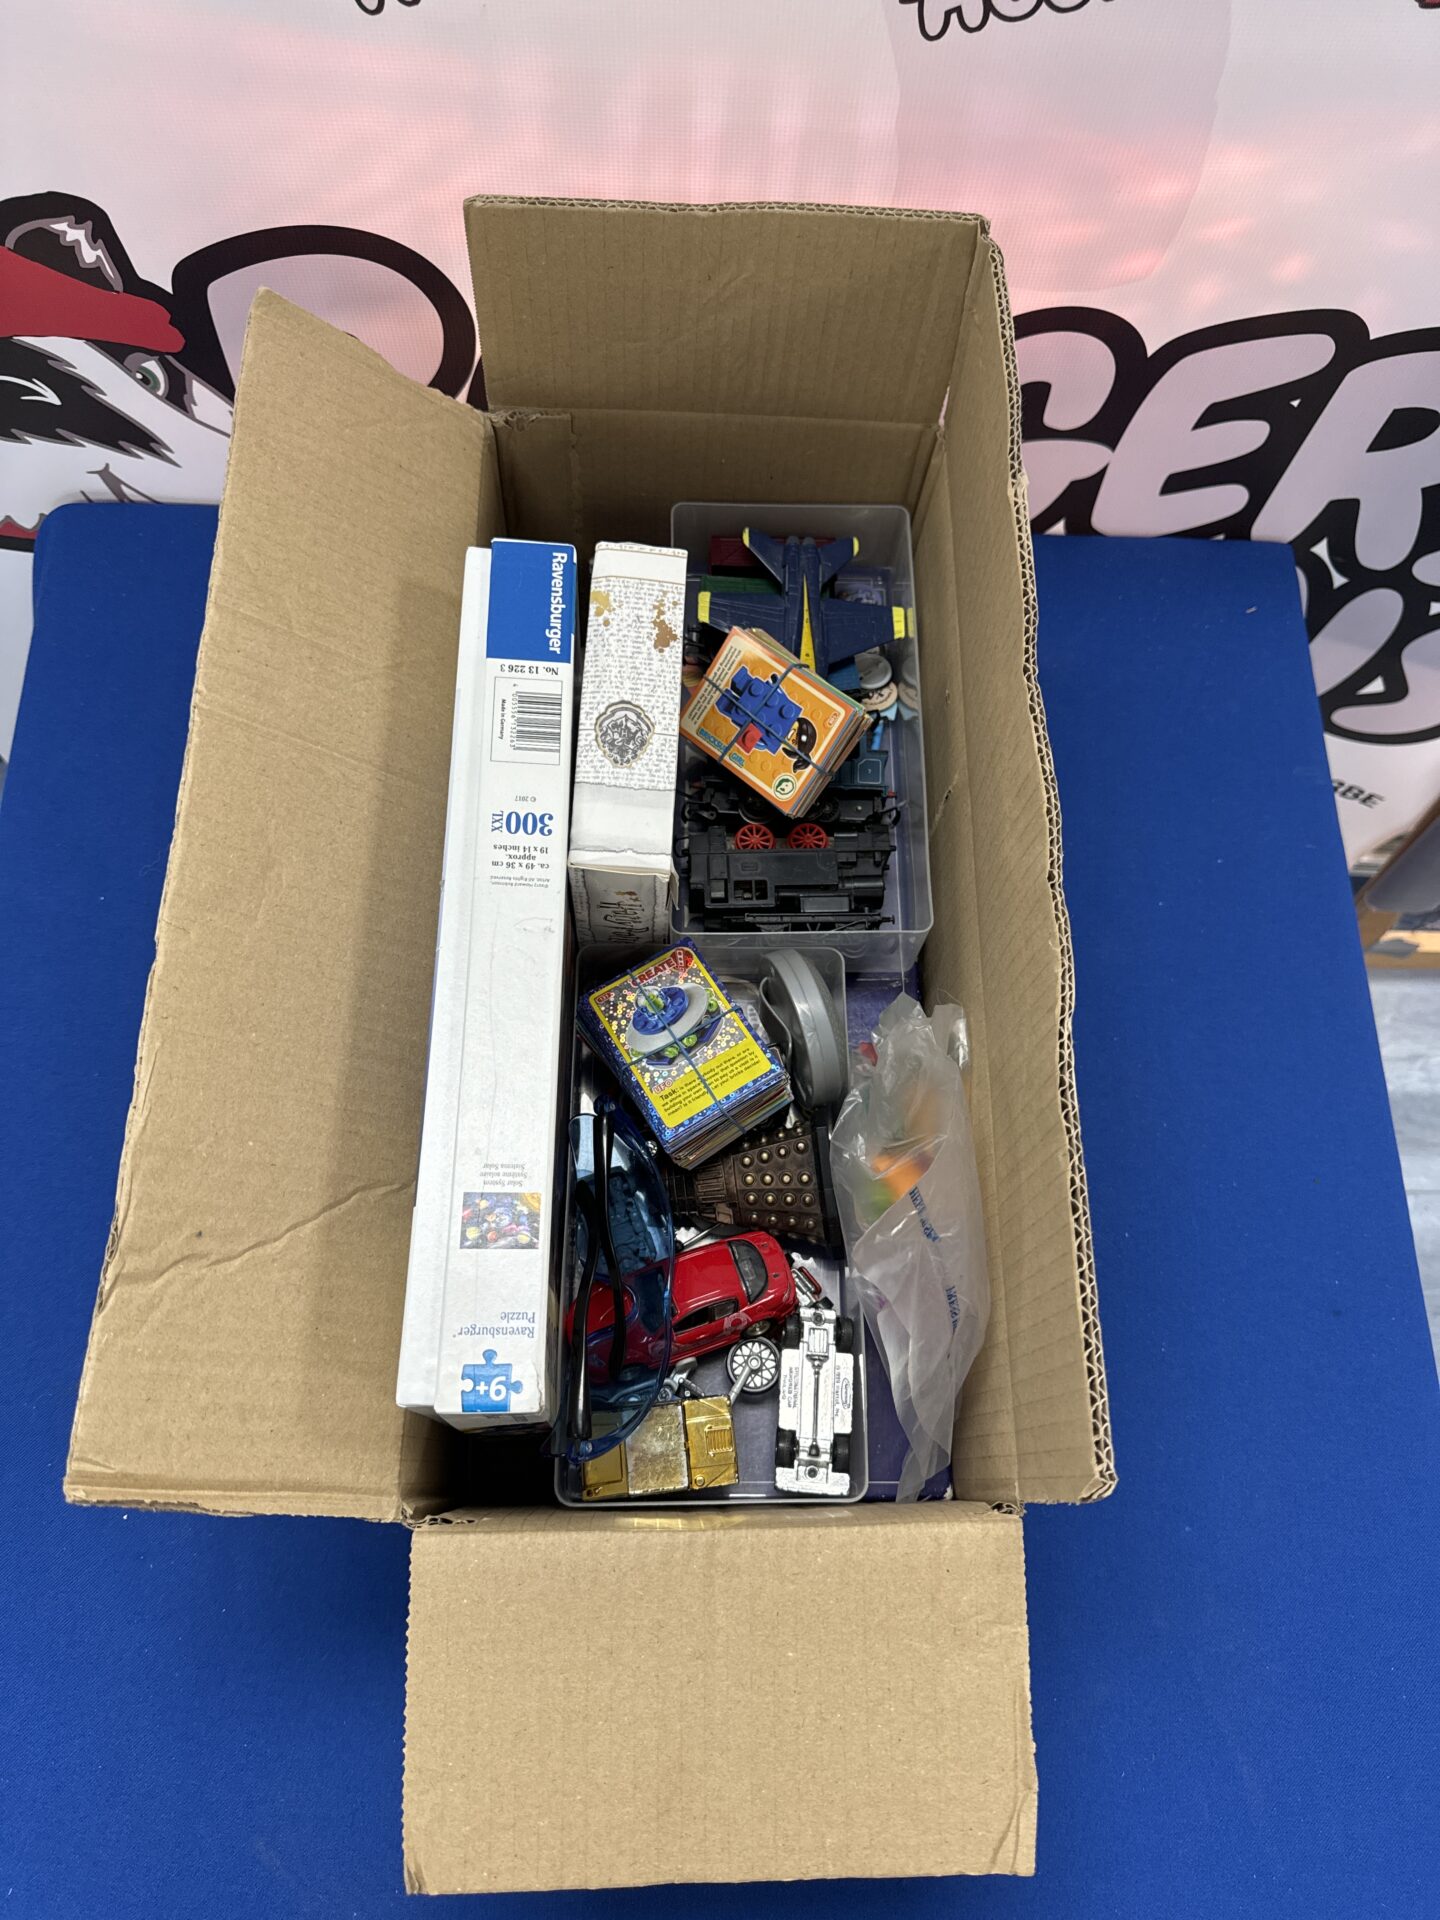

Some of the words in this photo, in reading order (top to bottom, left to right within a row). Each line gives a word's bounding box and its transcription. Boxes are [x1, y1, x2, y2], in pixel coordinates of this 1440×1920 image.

[546, 553, 567, 654] Ravensburger
[500, 664, 505, 672] 3
[508, 665, 525, 673] 226
[528, 666, 539, 674] 13
[542, 666, 559, 675] No.
[491, 810, 504, 833] XXL
[505, 812, 553, 836] 300
[493, 845, 520, 853] inches
[505, 854, 536, 862] approx.
[506, 861, 516, 869] 36
[525, 862, 535, 870] 49
[630, 958, 675, 988] CREATE
[652, 1079, 673, 1094] UFO
[659, 1089, 678, 1100] Task:
[506, 1179, 522, 1187] Solar
[500, 1310, 535, 1323] Puzzle
[476, 1375, 508, 1401] 9+
